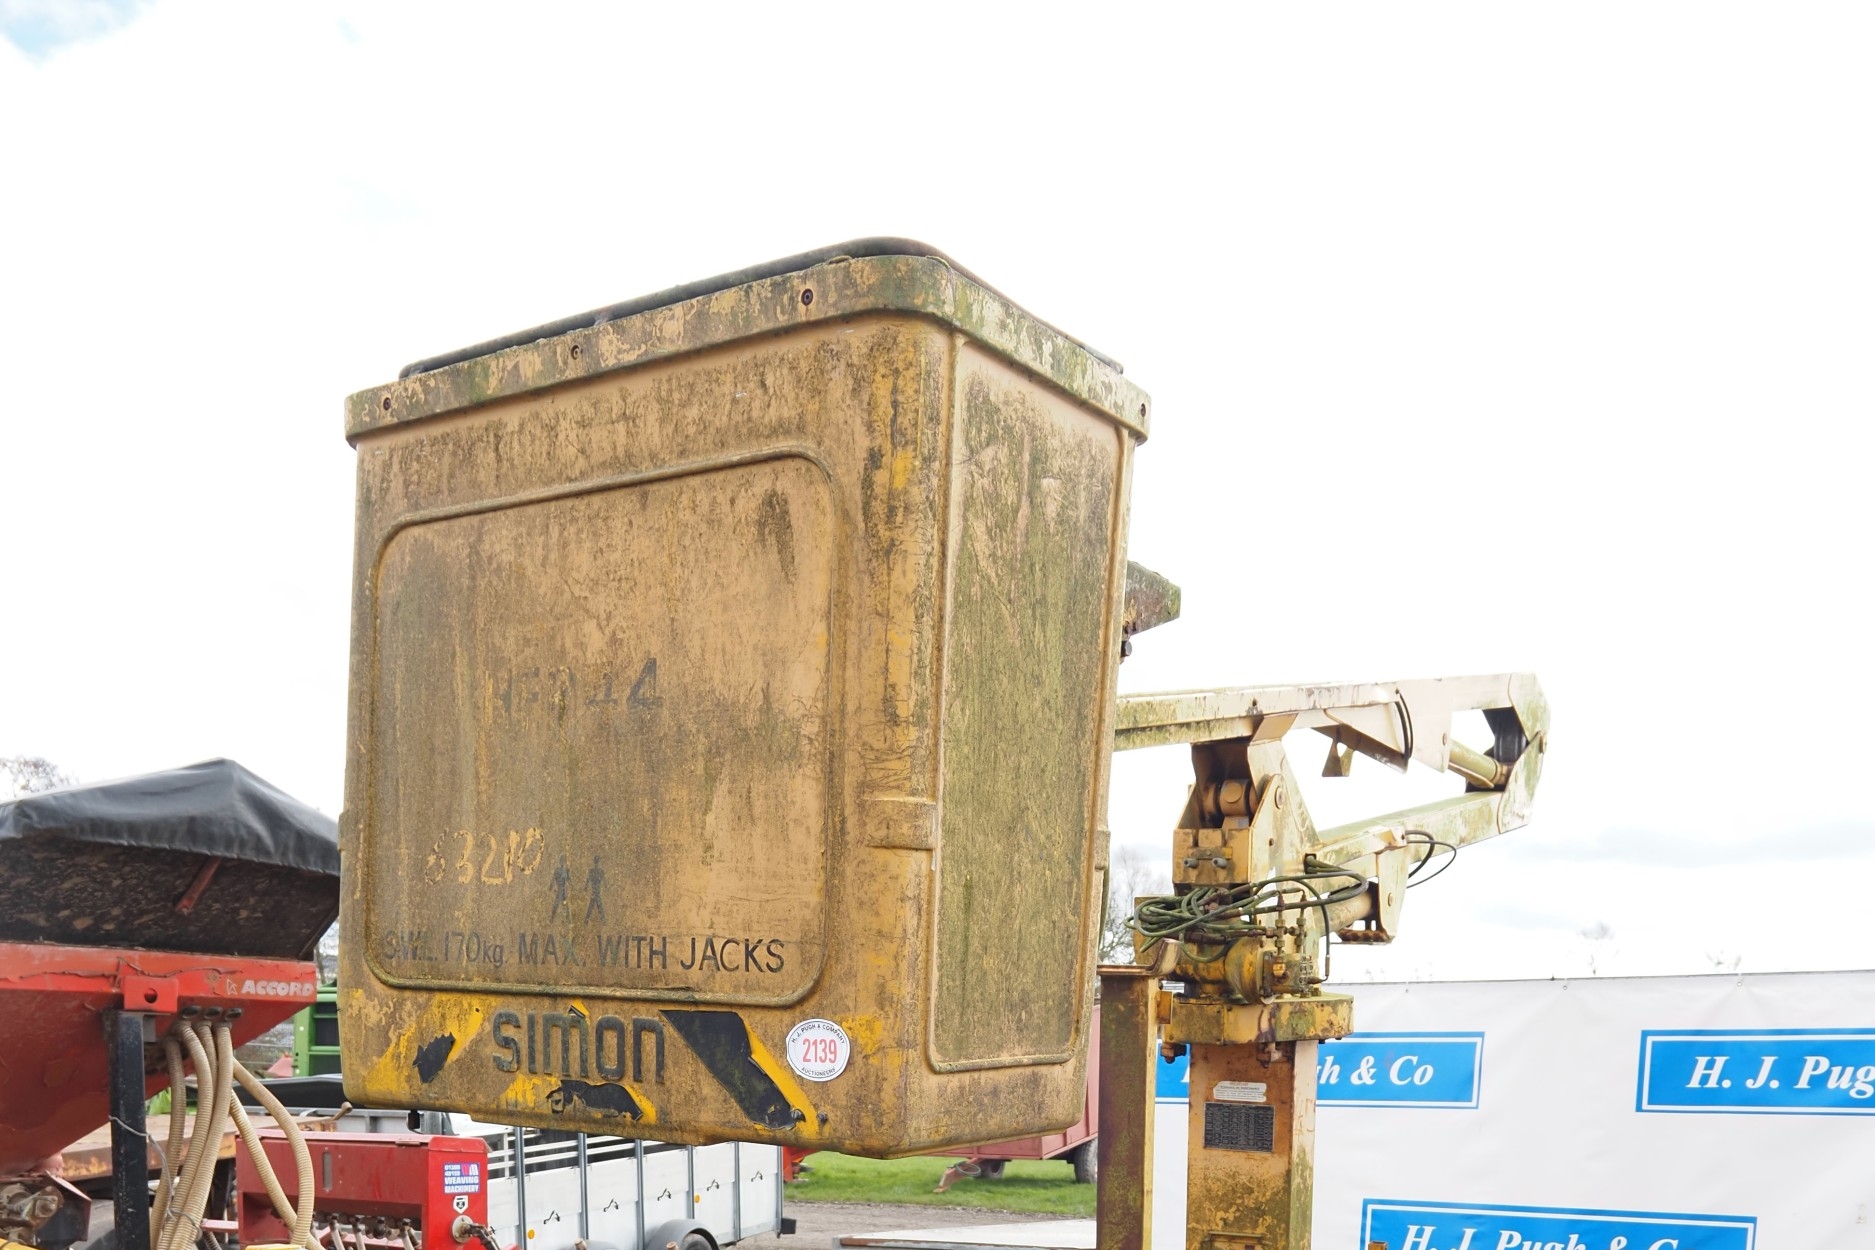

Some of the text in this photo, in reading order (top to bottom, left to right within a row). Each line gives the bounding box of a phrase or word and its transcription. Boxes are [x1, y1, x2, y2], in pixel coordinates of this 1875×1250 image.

[597, 935, 667, 970] WITH
[680, 937, 785, 973] JACKS
[241, 979, 315, 996] ACCORD
[801, 1023, 817, 1033] PUGH
[822, 1024, 845, 1044] COMPANY
[802, 1038, 838, 1063] 2139
[801, 1067, 836, 1076] AUCTIONEERS
[1351, 1055, 1376, 1085] &
[1389, 1055, 1434, 1086] Co
[1685, 1056, 1732, 1088] H.
[1745, 1056, 1780, 1089] J.
[444, 1176, 479, 1185] WEAVING
[444, 1185, 479, 1194] MACHINERY
